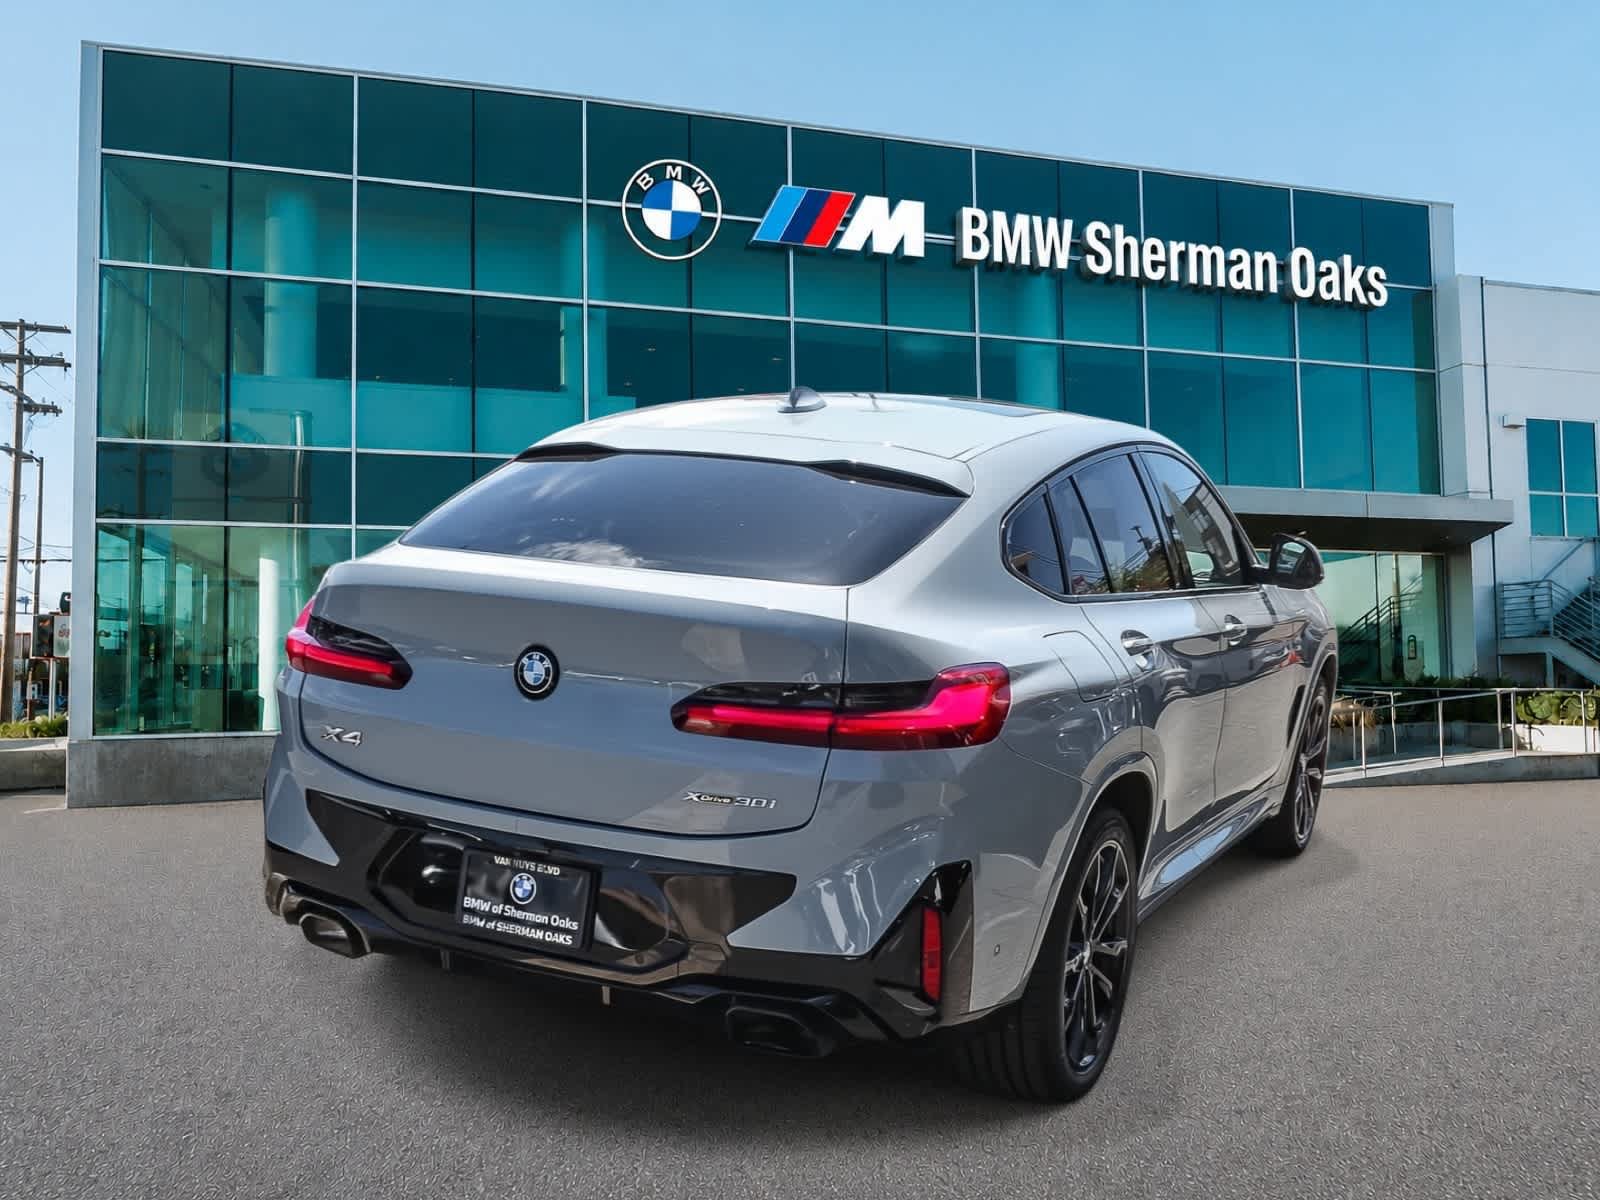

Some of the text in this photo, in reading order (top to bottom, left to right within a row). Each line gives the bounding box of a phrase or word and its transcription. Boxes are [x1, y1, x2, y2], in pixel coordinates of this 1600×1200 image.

[636, 165, 711, 196] BMW
[960, 206, 1388, 308] BMW Sherman Oaks
[320, 725, 362, 747] X4
[494, 855, 512, 867] VAN
[463, 897, 580, 931] BMW of Sherman Oaks
[496, 921, 544, 941] SHERMAN
[544, 931, 573, 945] OAKS
